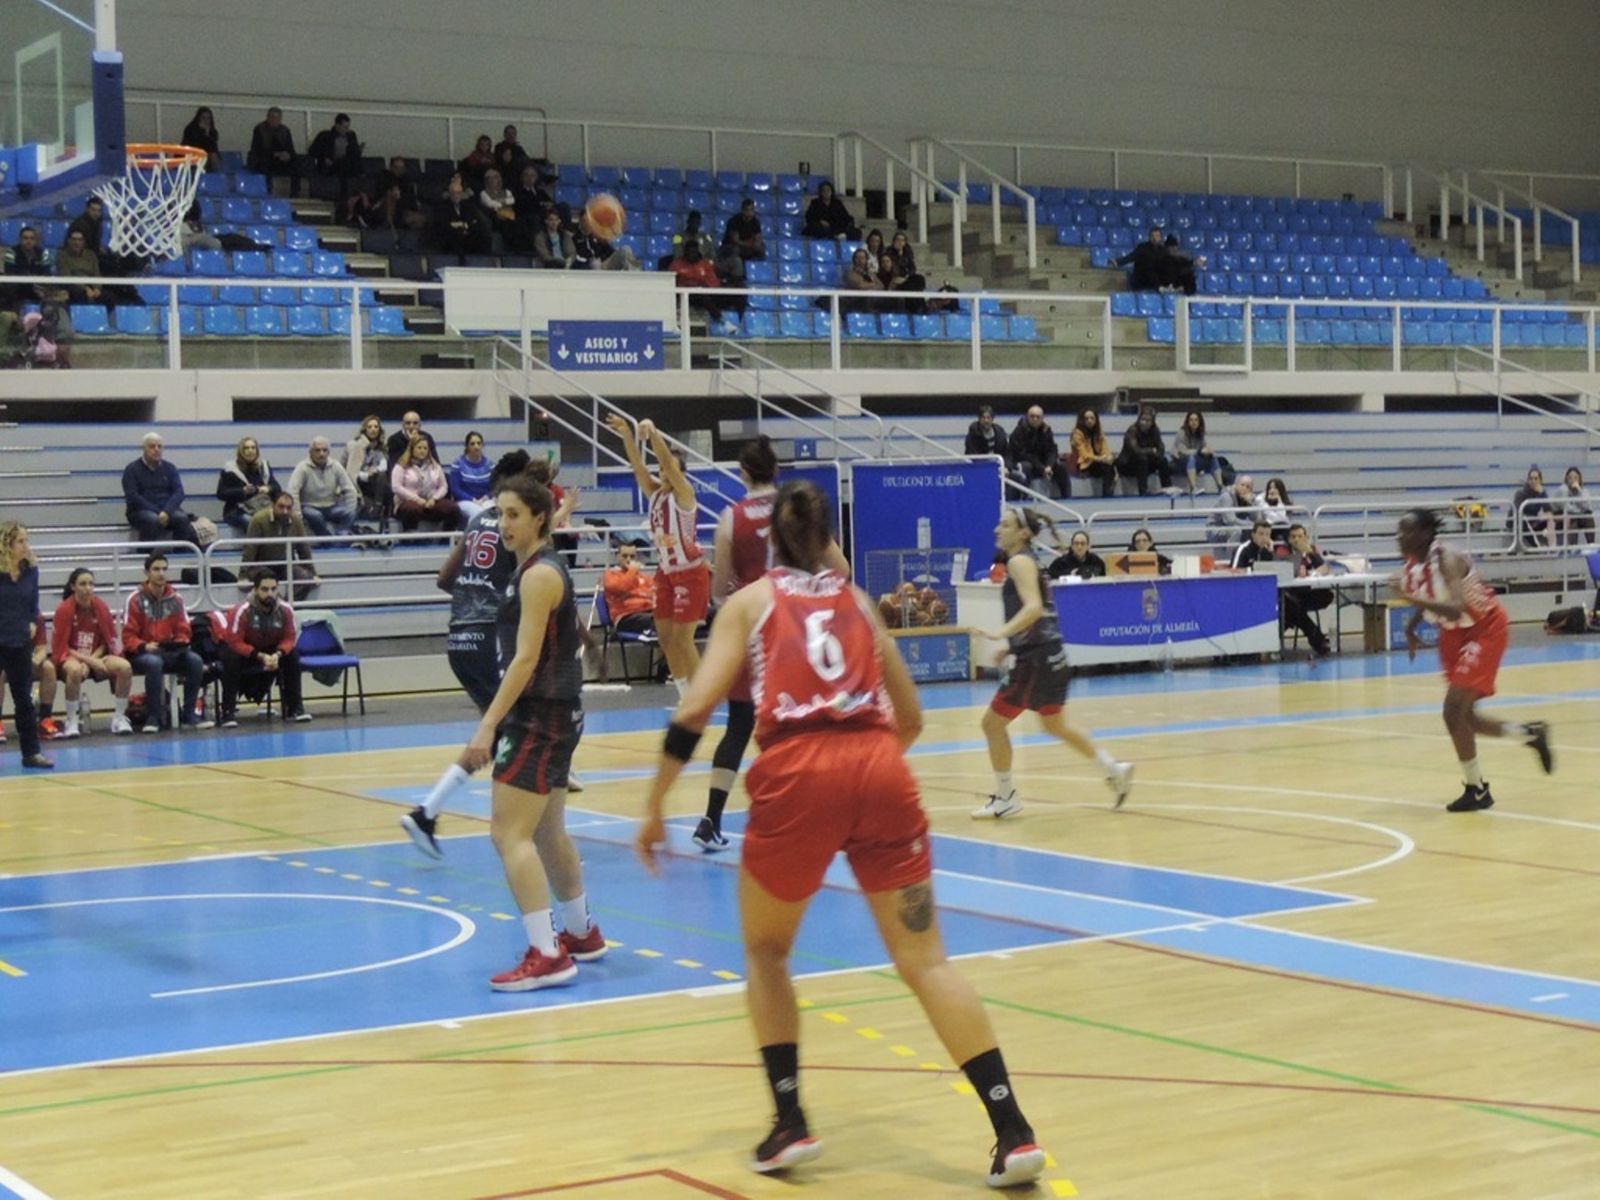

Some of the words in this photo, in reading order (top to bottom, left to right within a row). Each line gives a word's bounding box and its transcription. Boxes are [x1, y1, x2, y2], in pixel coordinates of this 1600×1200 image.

[584, 338, 618, 349] ASEOS
[621, 338, 628, 349] Y
[575, 351, 638, 364] VESTUARIOS
[464, 530, 500, 569] 16
[1099, 624, 1150, 637] DIPUTACIÓN
[1164, 619, 1200, 633] ALMERÍA
[804, 609, 846, 682] 6
